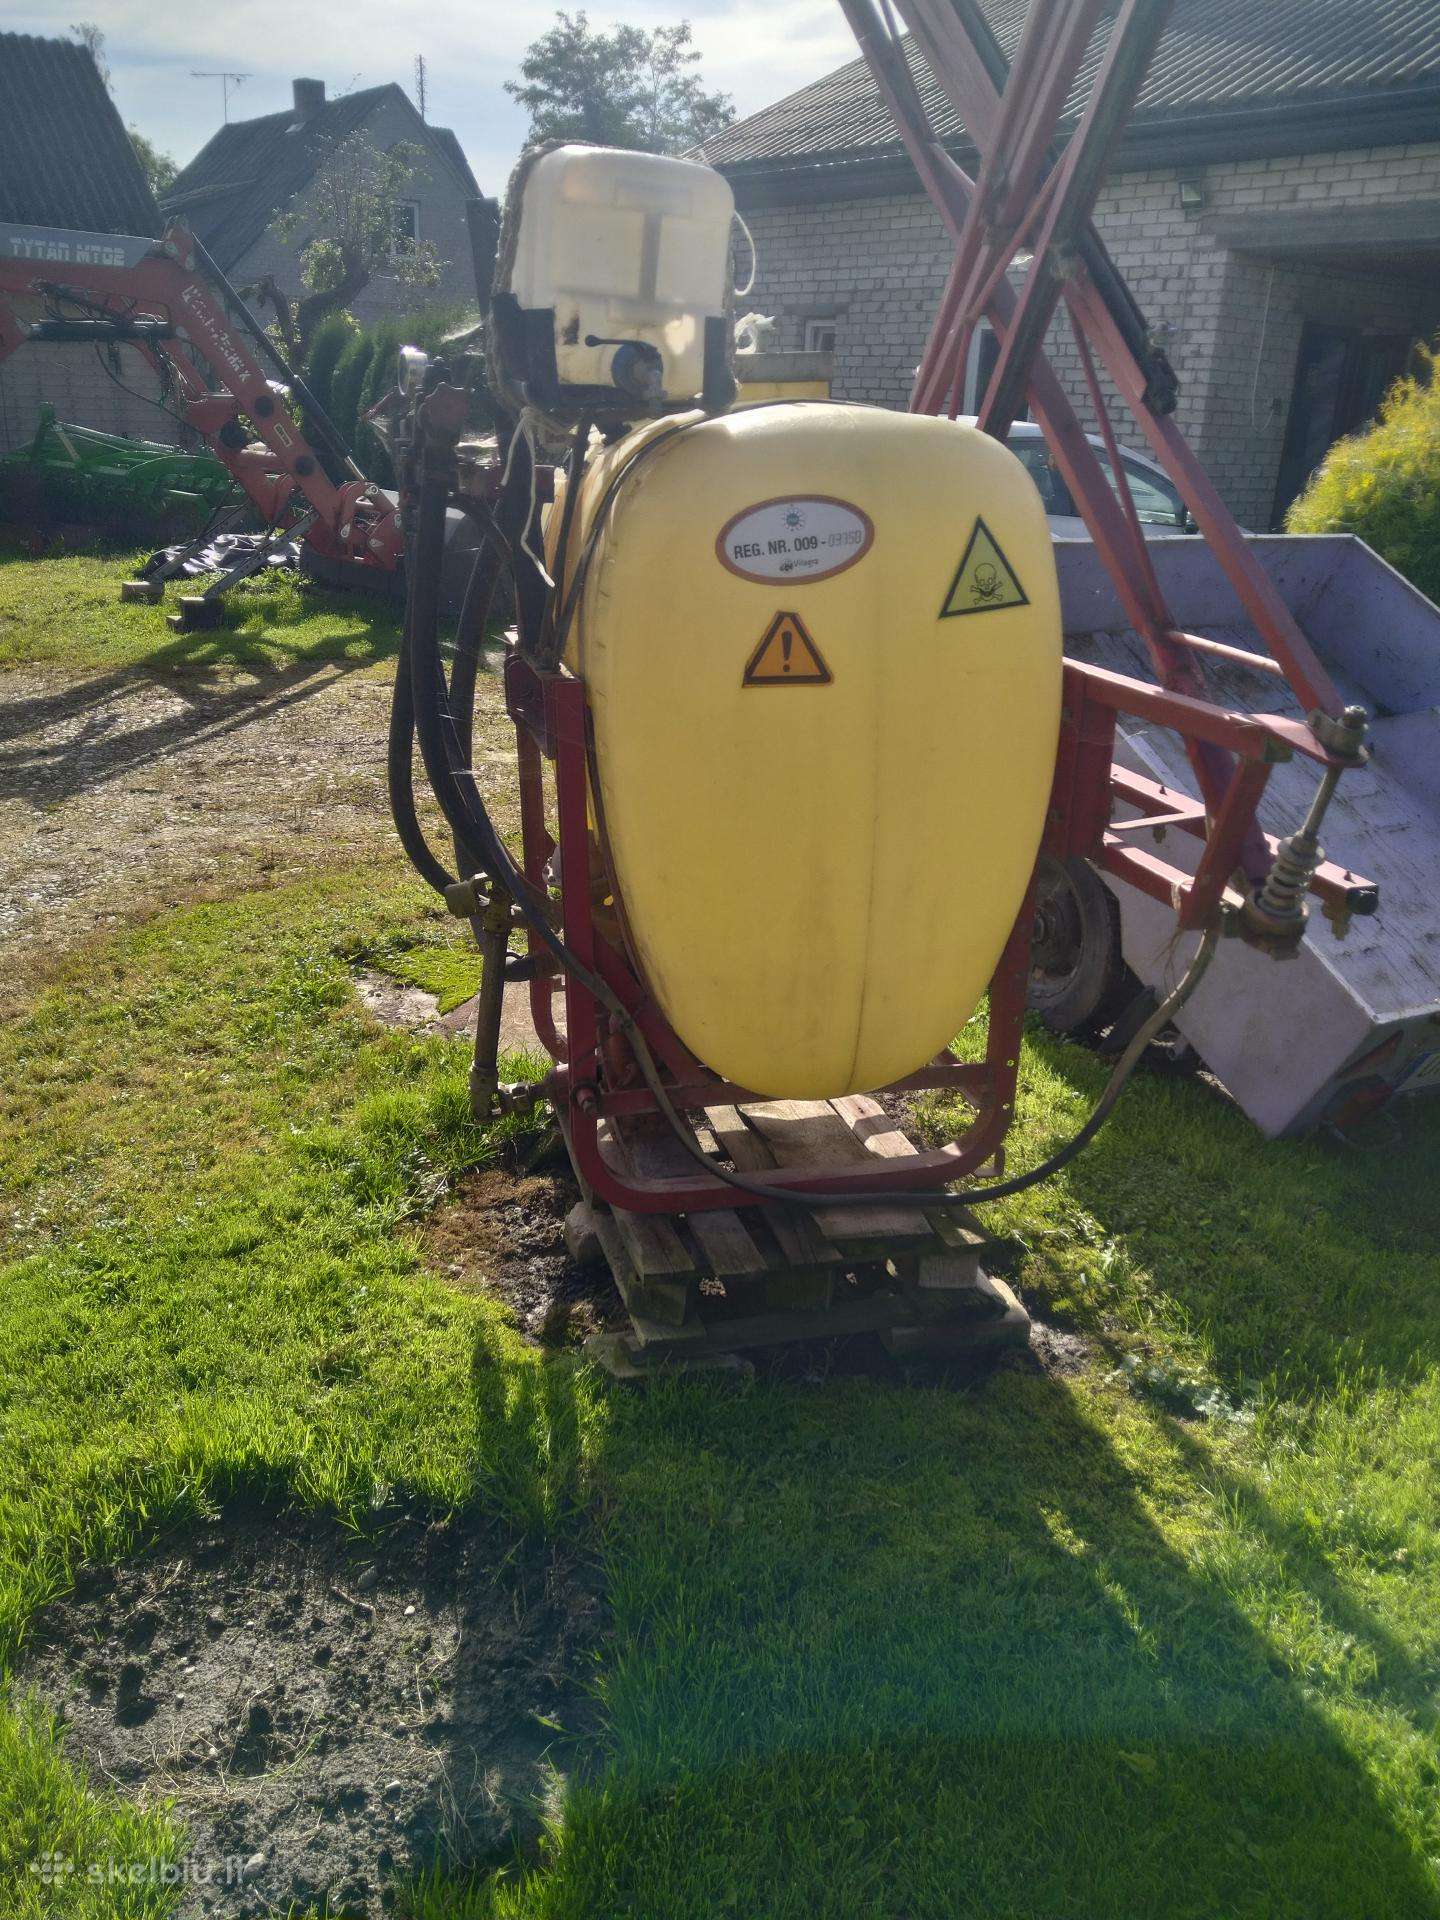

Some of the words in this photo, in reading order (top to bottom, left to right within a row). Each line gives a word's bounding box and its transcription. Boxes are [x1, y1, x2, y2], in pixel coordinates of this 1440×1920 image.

[733, 543, 766, 560] REG.
[768, 540, 791, 555] NR.
[793, 535, 818, 552] 009
